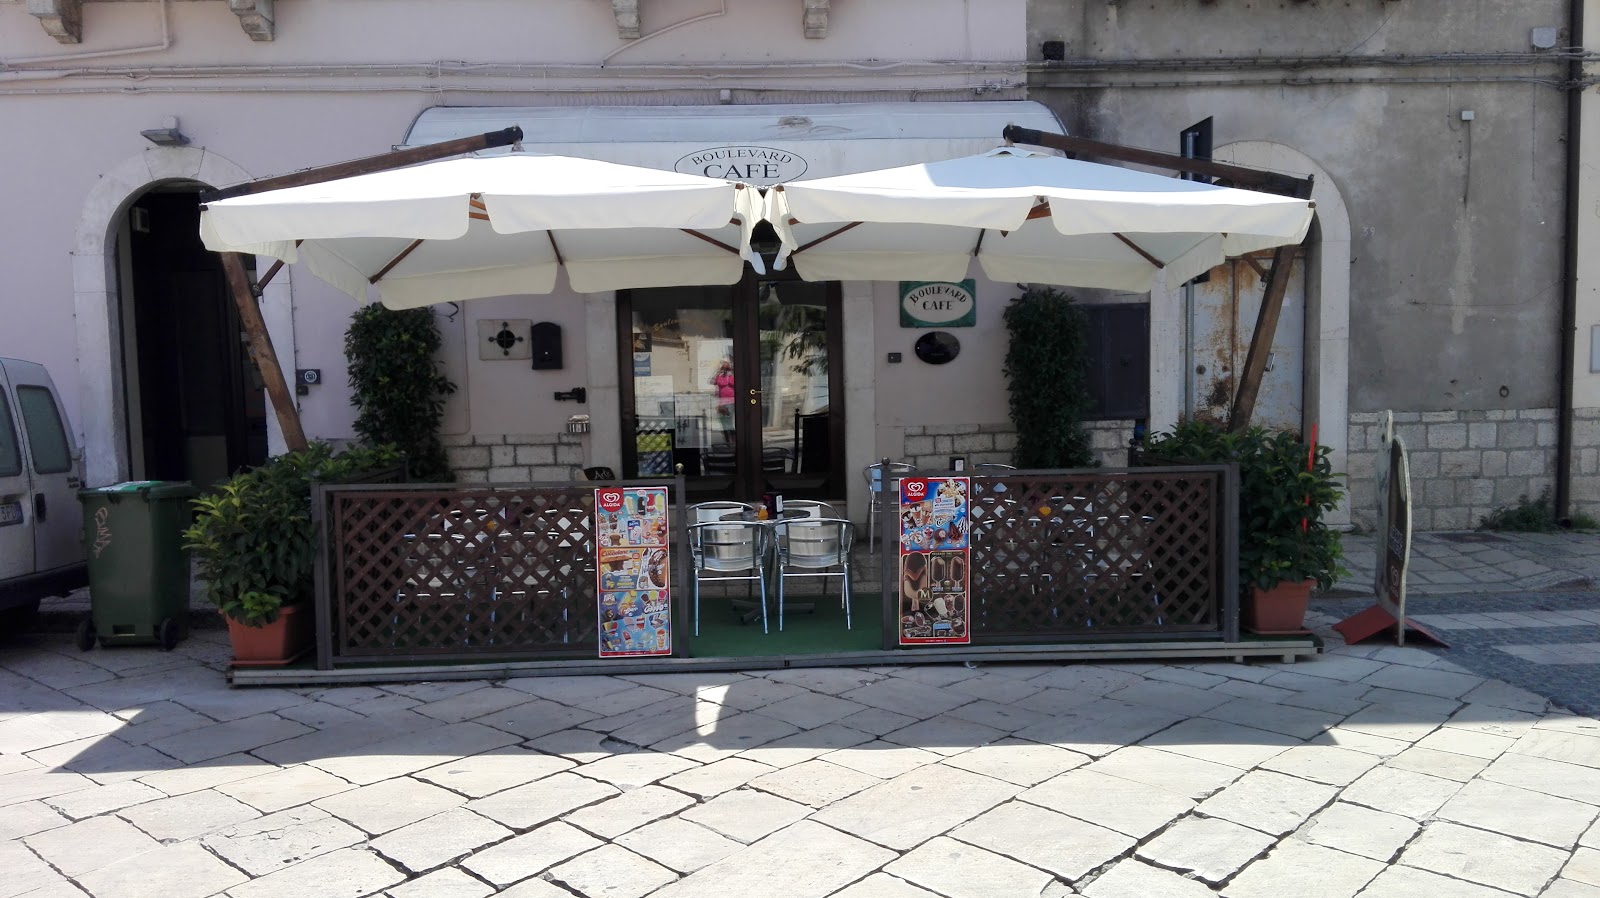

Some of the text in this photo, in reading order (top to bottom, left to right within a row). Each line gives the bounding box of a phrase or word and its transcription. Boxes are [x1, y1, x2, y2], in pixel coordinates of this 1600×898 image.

[691, 149, 792, 165] BOULEVARD
[703, 160, 780, 179] CAFÈ
[909, 286, 967, 306] BOULEVARD
[920, 590, 931, 598] M
